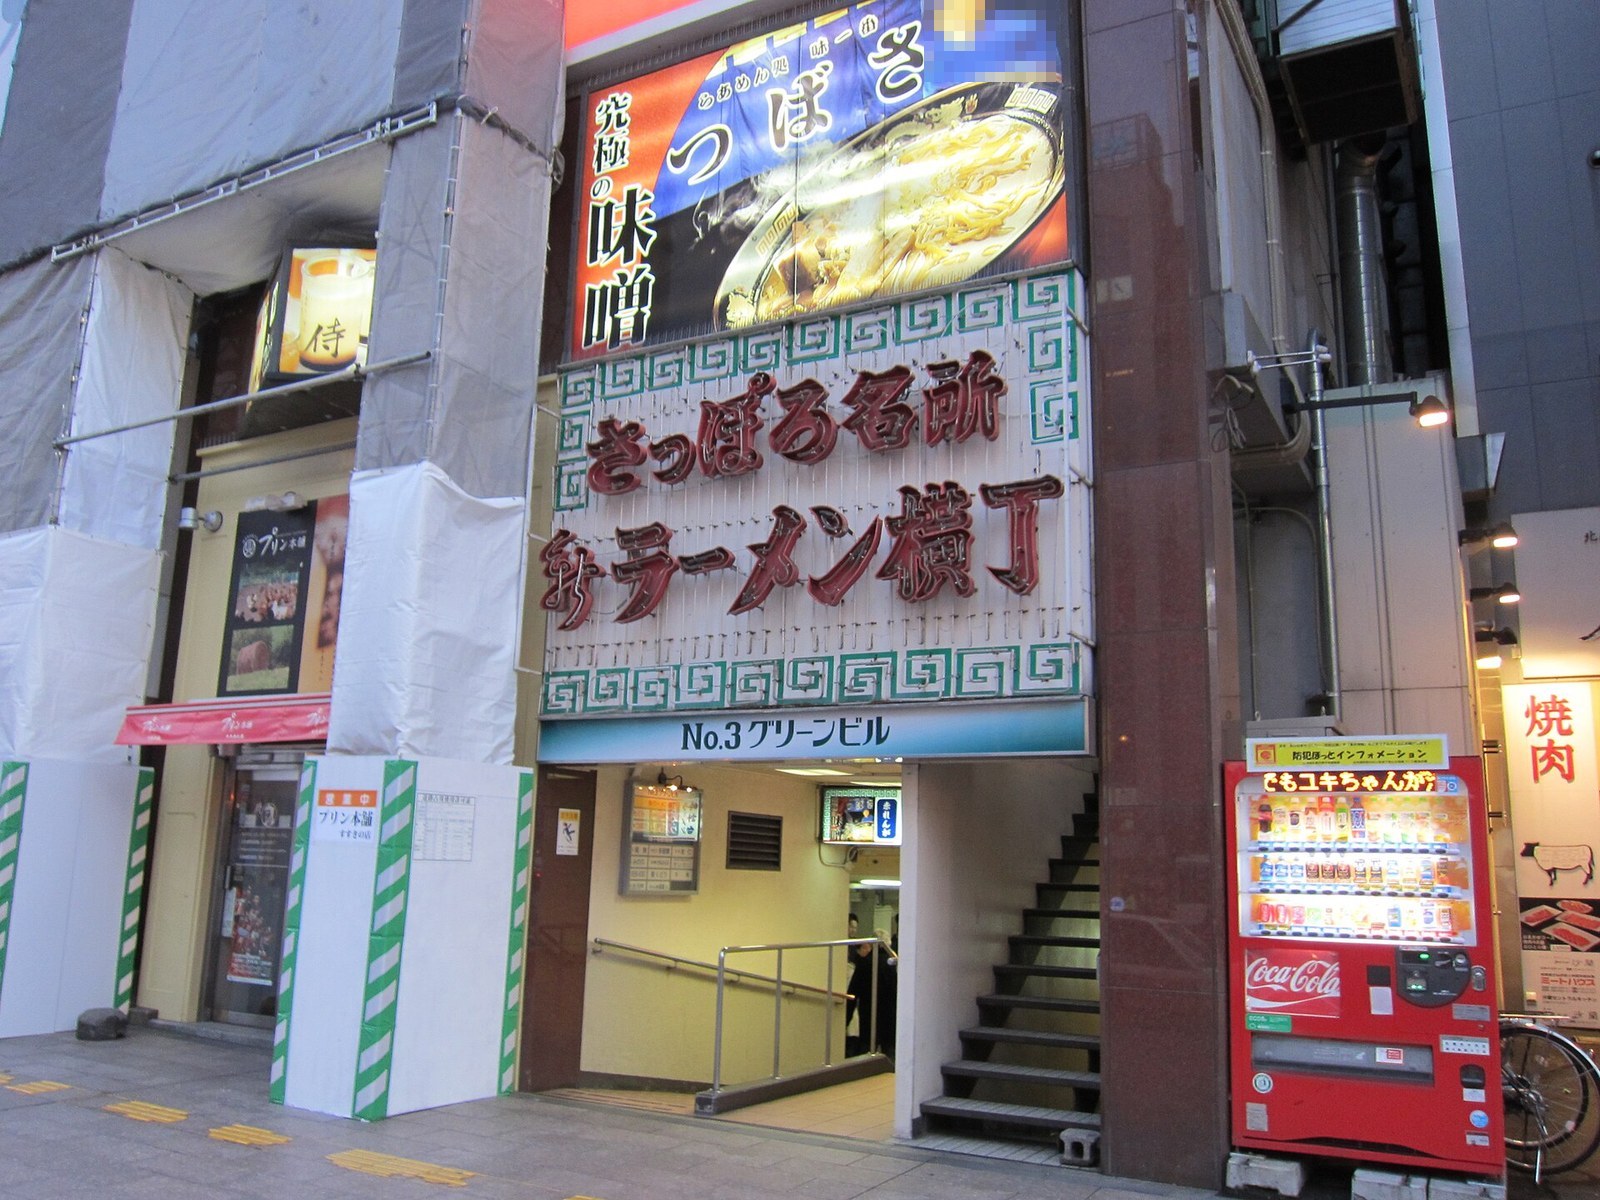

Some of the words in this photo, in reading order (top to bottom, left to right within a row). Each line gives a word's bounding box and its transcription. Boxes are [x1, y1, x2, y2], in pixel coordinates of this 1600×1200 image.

[665, 20, 924, 186] つばさ
[698, 57, 790, 110] らあめん処
[304, 317, 346, 358] 侍
[586, 349, 1008, 496] さっぽろ名所
[539, 474, 1064, 631] 新ラーメン横丁
[1524, 694, 1575, 784] 焼肉
[318, 809, 373, 827] プリン本舗
[1247, 957, 1340, 994] Coca-Cola
